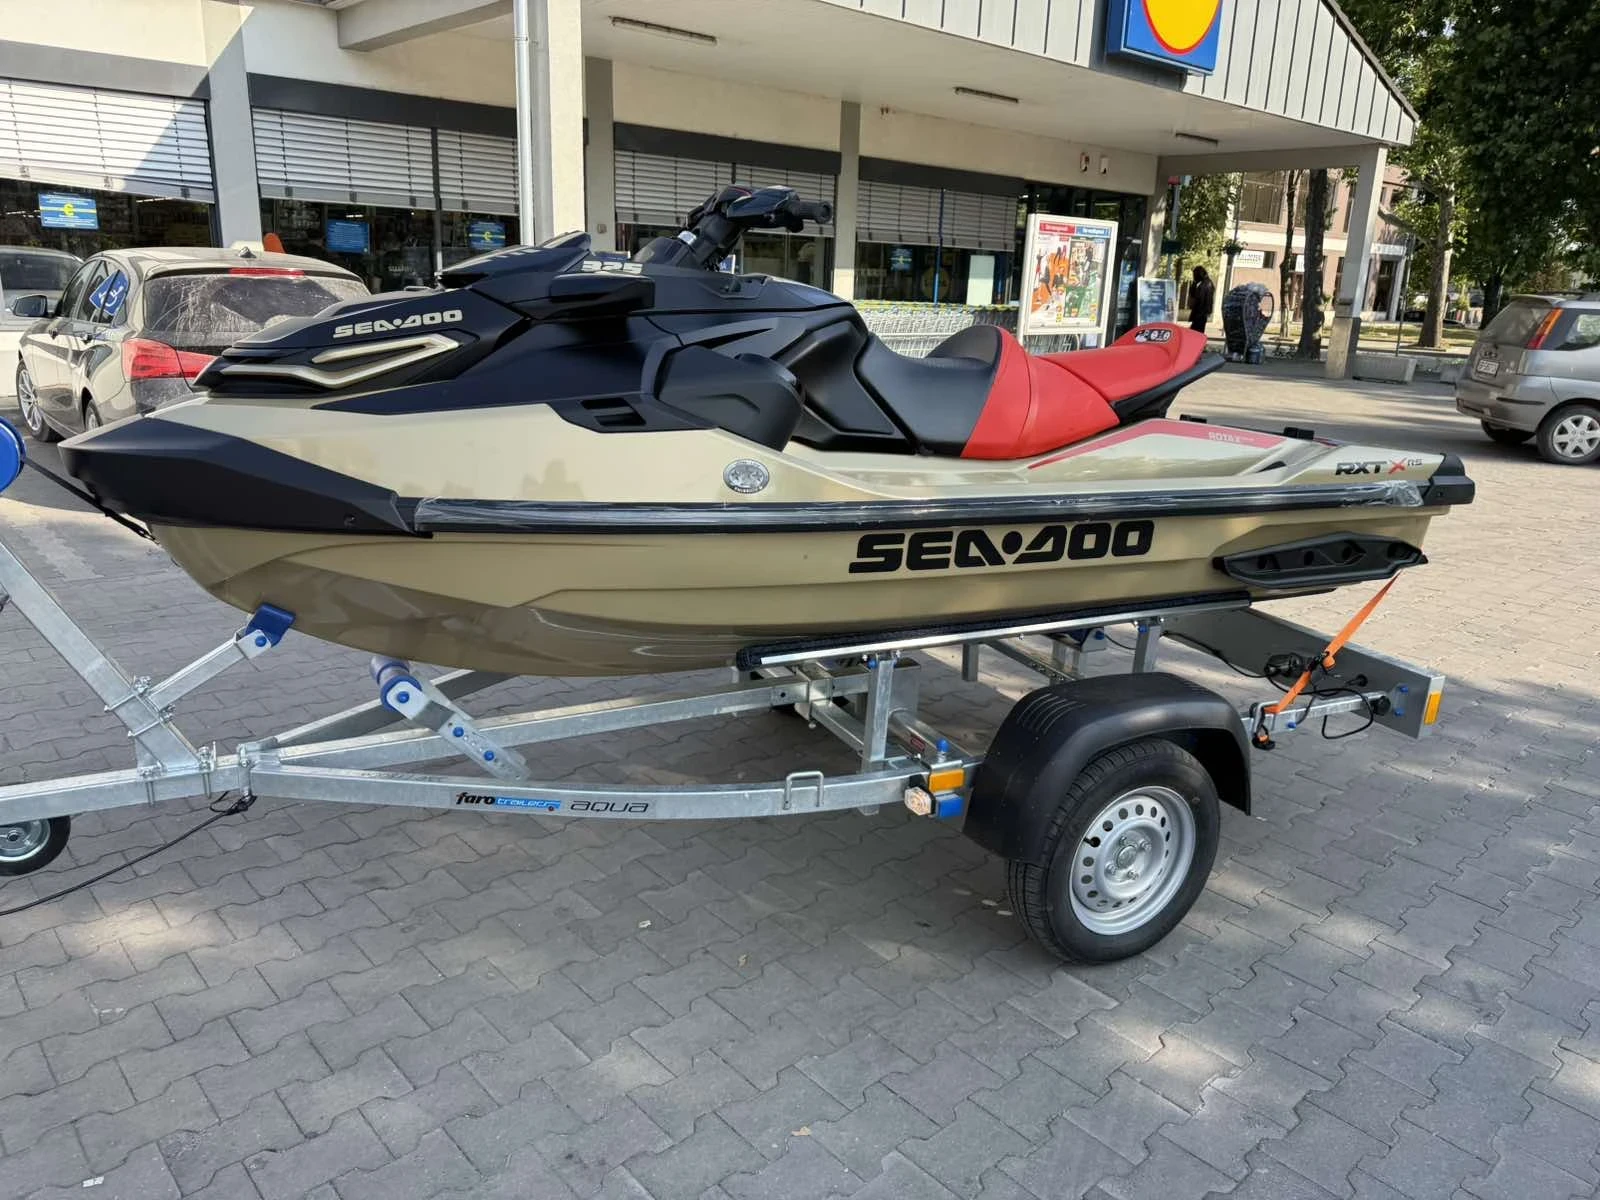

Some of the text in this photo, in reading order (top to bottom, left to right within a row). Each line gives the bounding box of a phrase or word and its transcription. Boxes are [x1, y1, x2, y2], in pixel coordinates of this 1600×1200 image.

[581, 260, 643, 275] 325
[1208, 431, 1241, 443] ROTAX
[1335, 460, 1387, 476] RXT
[456, 791, 496, 805] faro
[570, 800, 649, 813] aqua
